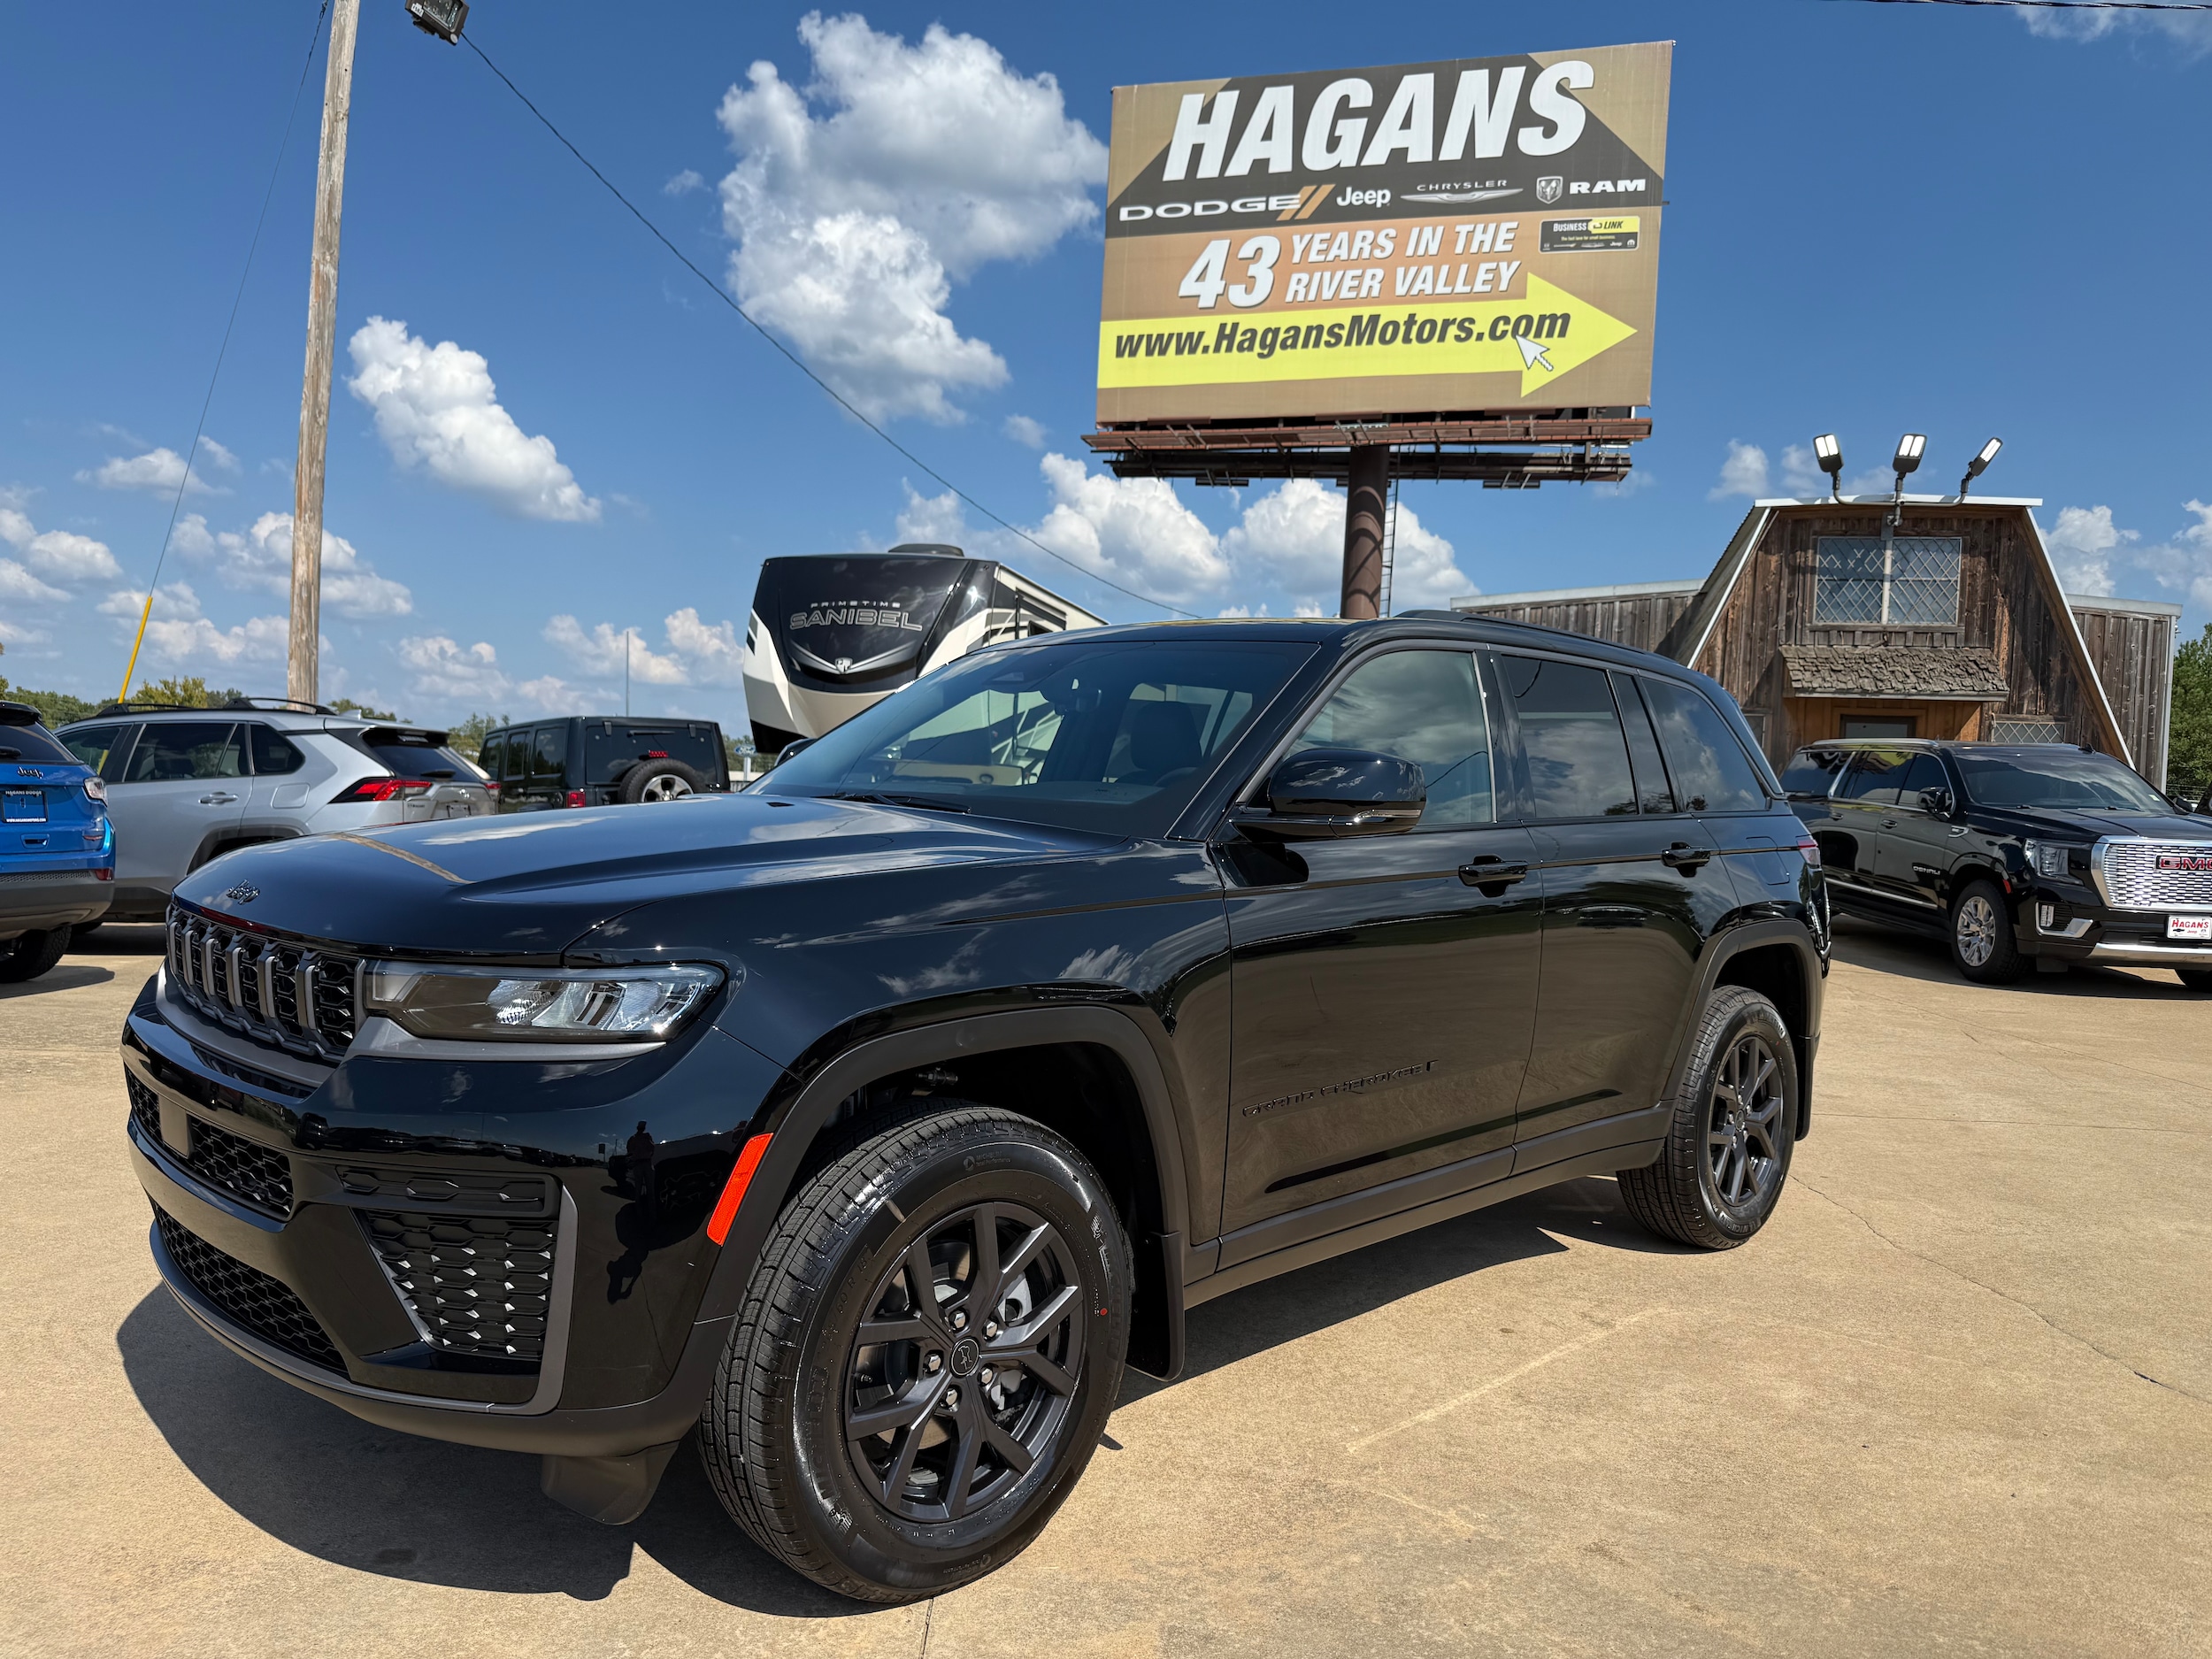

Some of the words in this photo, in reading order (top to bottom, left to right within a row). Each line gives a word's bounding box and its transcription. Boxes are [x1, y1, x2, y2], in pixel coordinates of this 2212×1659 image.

[1162, 59, 1594, 182] HAGANS
[1118, 193, 1302, 222] DODGE
[1336, 187, 1391, 208] Jeep
[1417, 180, 1508, 192] CHRYSLER
[1569, 179, 1647, 195] RAM
[1290, 229, 1400, 265] YEARS
[1405, 226, 1449, 257] IN
[1455, 221, 1519, 253] THE
[1553, 222, 1587, 232] BUSINESS
[1603, 220, 1624, 230] LINK
[1178, 235, 1281, 310] 43
[1285, 266, 1384, 303] RIVER
[1394, 260, 1522, 296] VALLEY
[1115, 311, 1571, 359] www.HagansMotors.com
[789, 609, 923, 632] SANIBEL
[17, 765, 44, 780] Jeep
[1913, 865, 1940, 876] DENALI
[226, 879, 261, 905] Jeep
[2171, 919, 2209, 929] HAGANS
